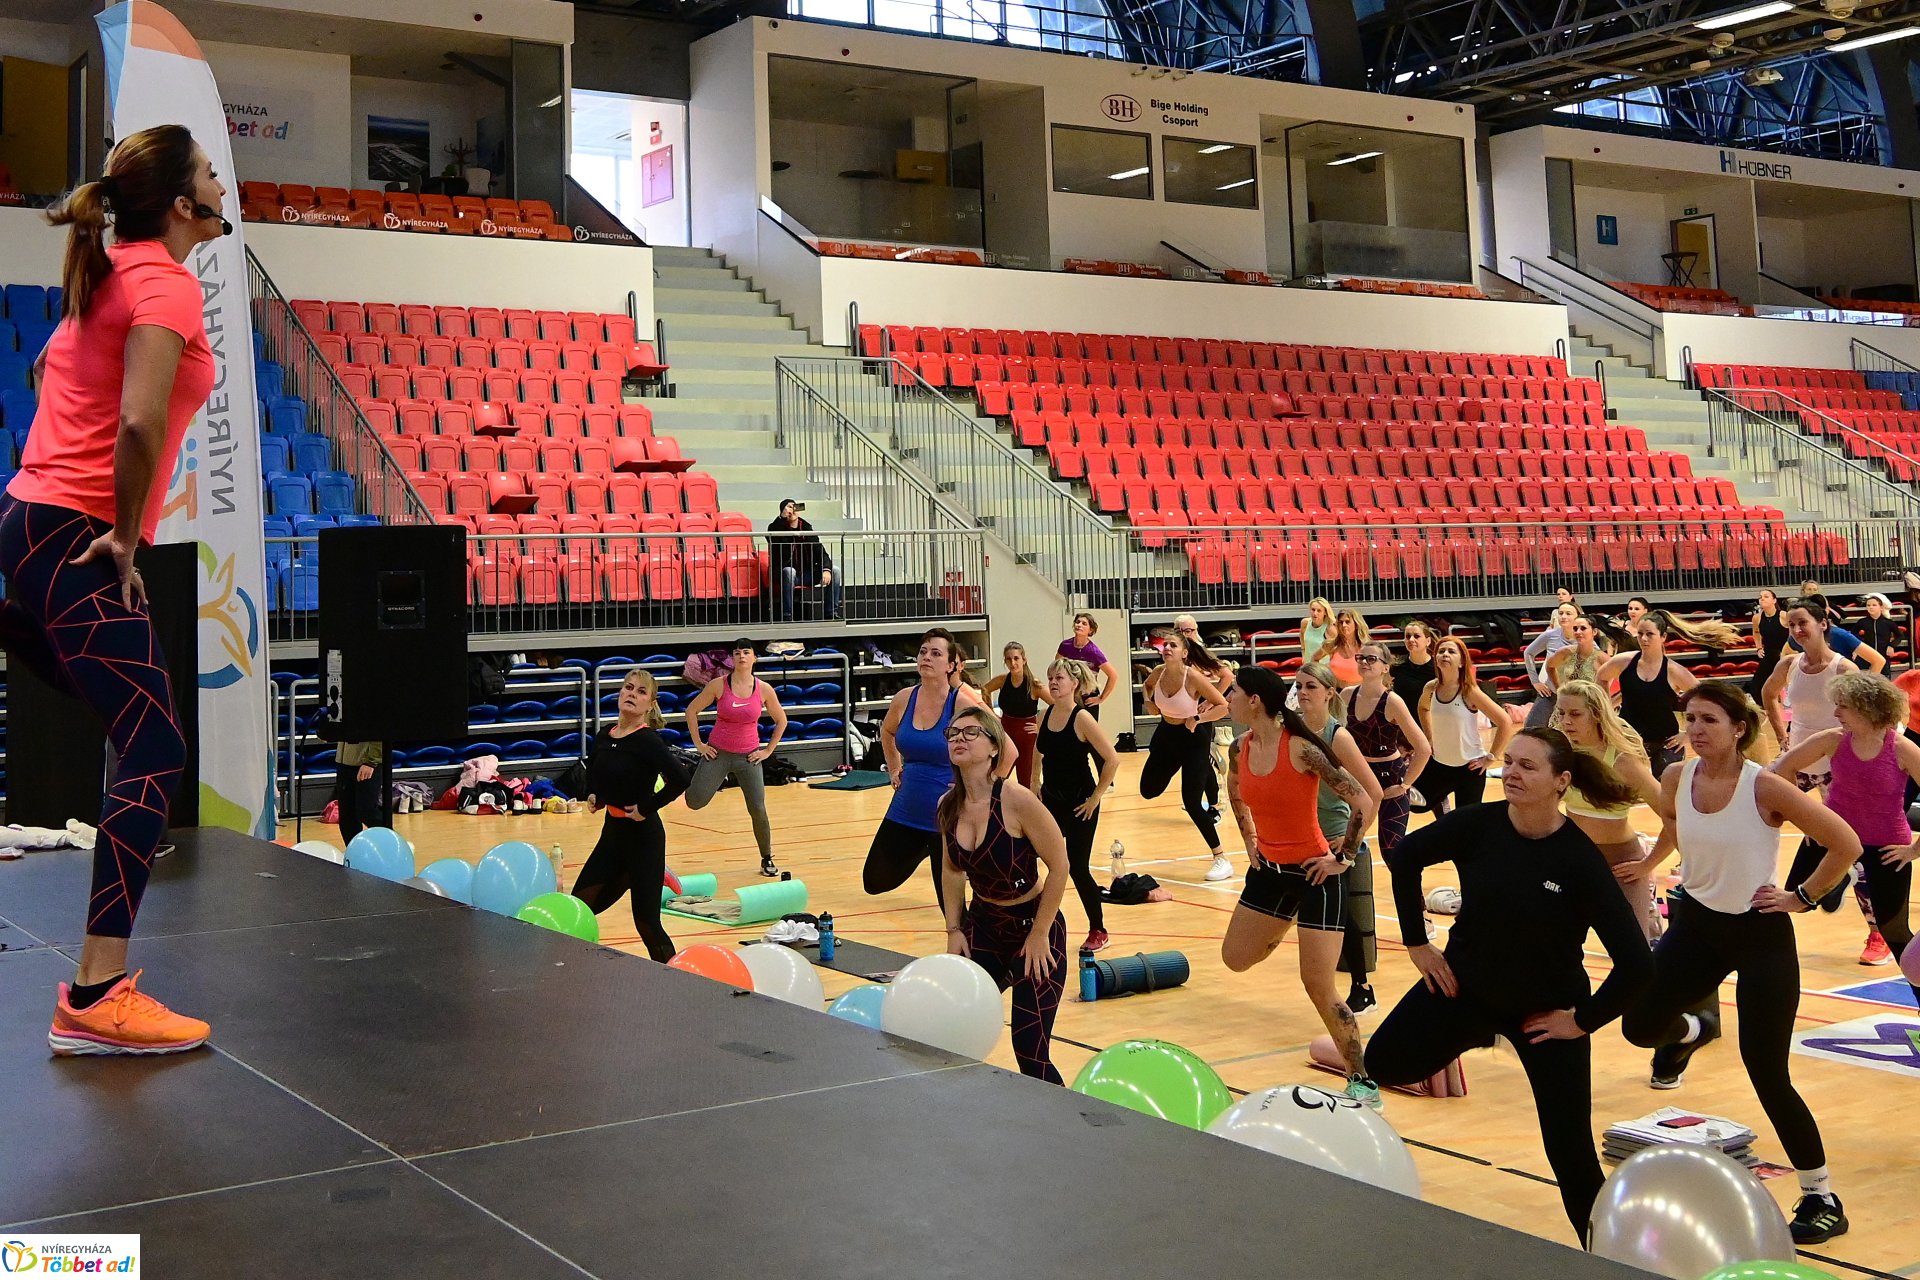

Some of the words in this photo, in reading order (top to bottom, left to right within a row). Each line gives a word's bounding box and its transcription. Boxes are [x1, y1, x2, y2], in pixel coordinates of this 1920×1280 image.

[1150, 99, 1171, 111] Bige
[1174, 102, 1209, 116] Holding
[1162, 114, 1199, 127] Csoport
[1738, 160, 1792, 180] HÜBNER
[402, 218, 449, 228] NYÍREGYHÁZA
[498, 224, 543, 235] NYÍREGYHÁZA
[590, 231, 634, 241] NYÍREGYHÁZA
